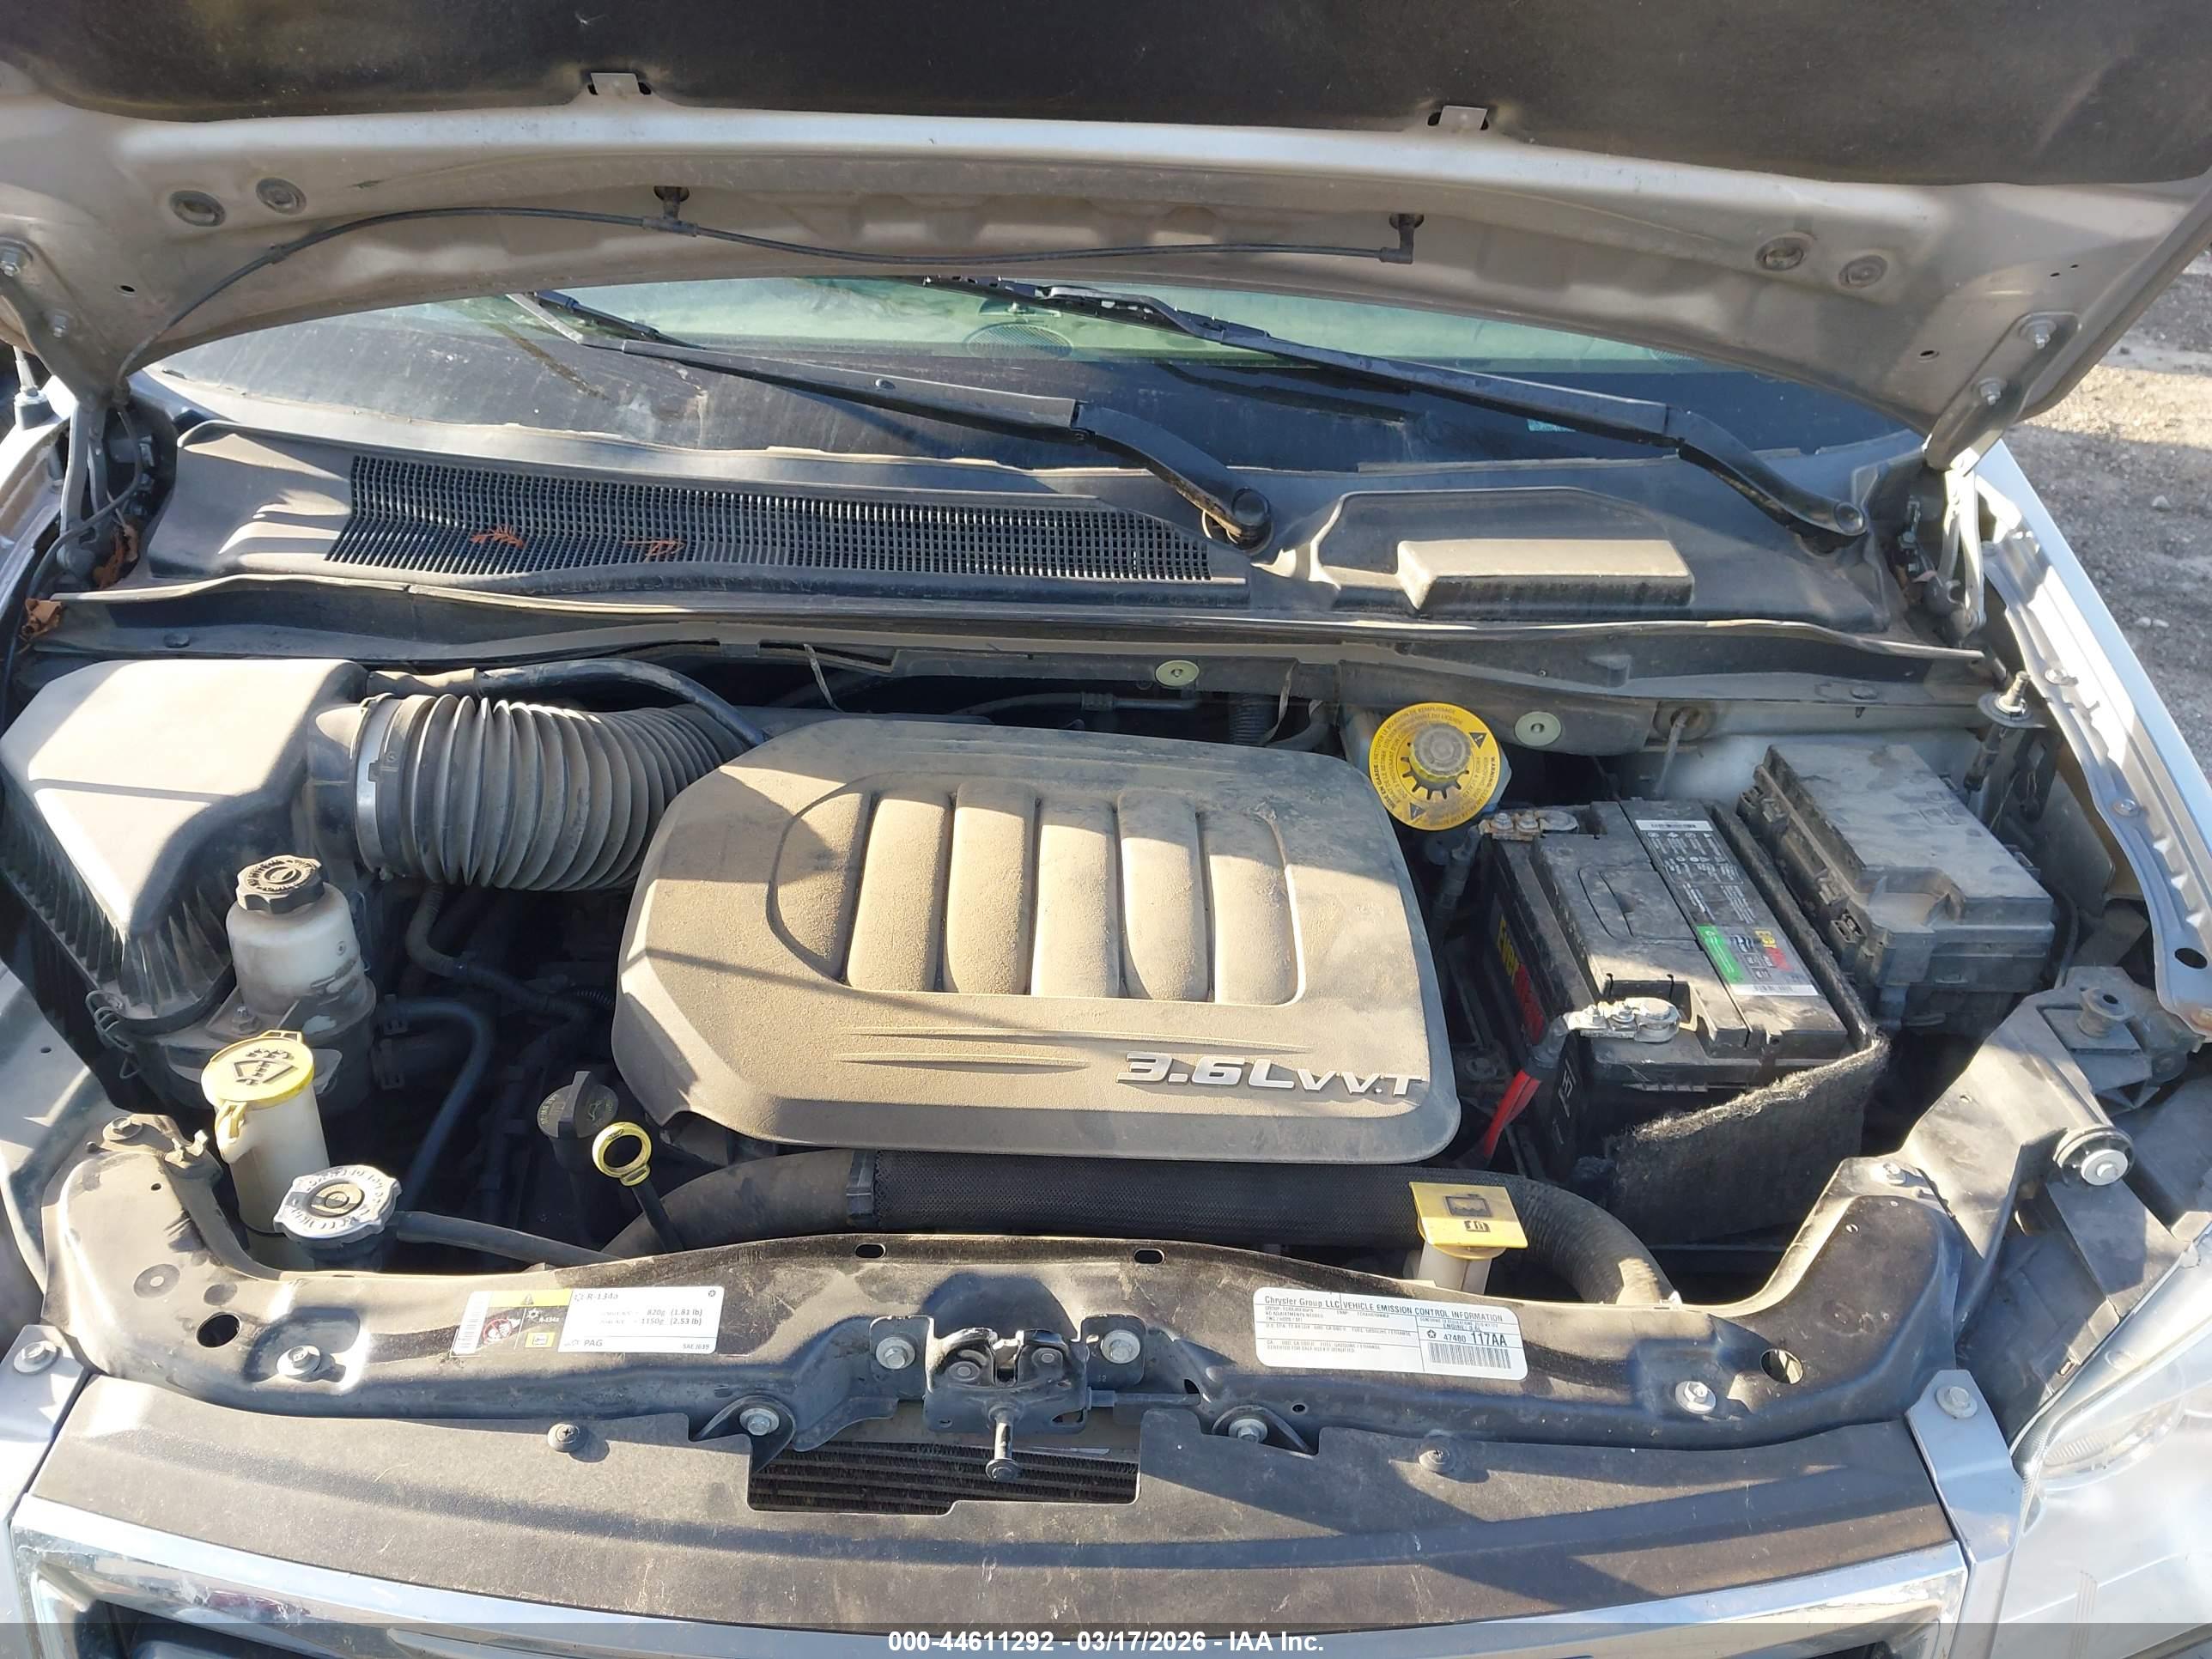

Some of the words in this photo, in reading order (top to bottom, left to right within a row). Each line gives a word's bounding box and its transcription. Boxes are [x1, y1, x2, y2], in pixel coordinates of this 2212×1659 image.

[1116, 1052, 1295, 1090] 3.6L
[1265, 1296, 1297, 1305] Chrysler
[1299, 1298, 1322, 1308] Group
[1343, 1301, 1374, 1310] VEHICLE
[1376, 1304, 1413, 1314] EMISSION
[1414, 1307, 1449, 1317] CONTROL
[1451, 1310, 1503, 1322] INFORMATION
[1443, 1334, 1466, 1342] 47480
[1472, 1332, 1507, 1346] 117AA
